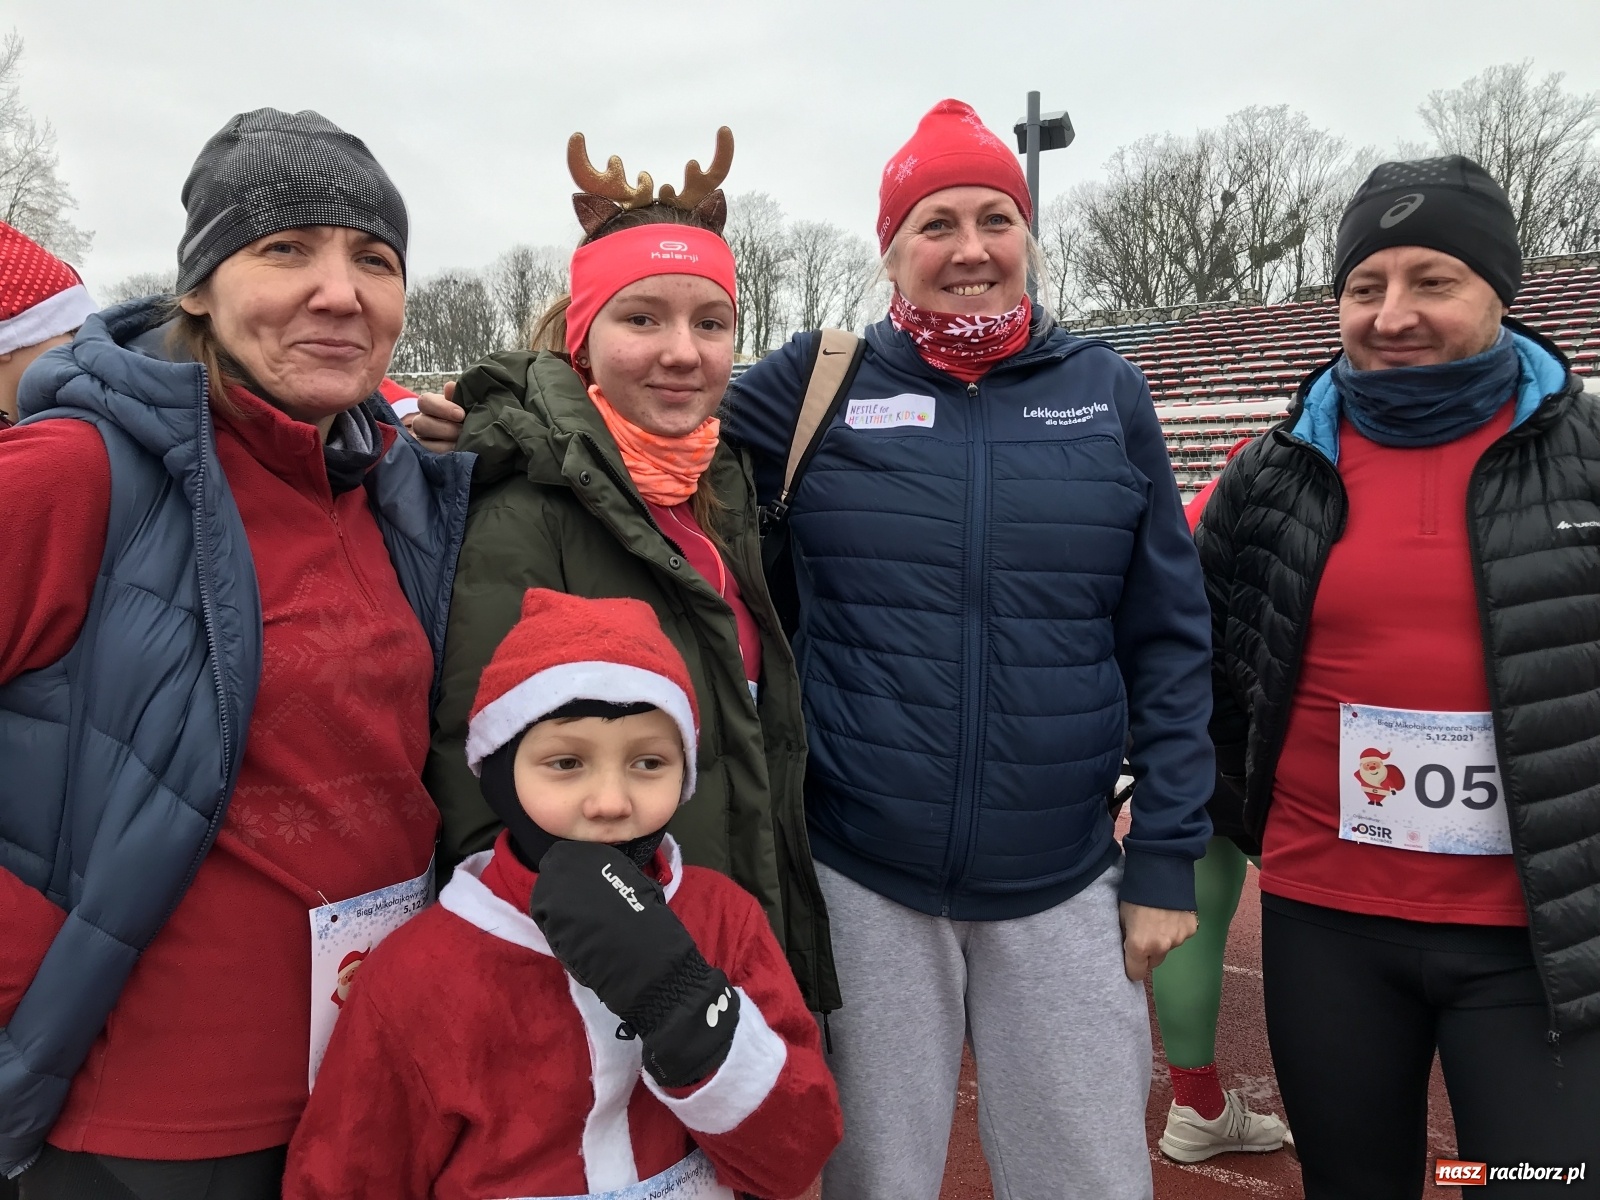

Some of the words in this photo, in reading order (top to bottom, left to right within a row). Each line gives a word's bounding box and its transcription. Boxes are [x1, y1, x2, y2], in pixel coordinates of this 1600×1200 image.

[651, 251, 699, 263] Kalenji
[848, 413, 893, 425] HEALTHIER
[896, 411, 915, 422] KIDS
[1023, 402, 1109, 418] Lekkoatletyka
[1395, 720, 1443, 733] Mikołajkowy
[1465, 724, 1492, 732] Nordic
[1426, 734, 1474, 742] 5.12.2021
[1414, 763, 1499, 811] 05
[1357, 823, 1392, 840] OSiR
[356, 907, 374, 918] Bieg
[375, 891, 419, 911] Mikołajkowy
[649, 1183, 675, 1200] Nordic
[676, 1166, 699, 1186] Walking
